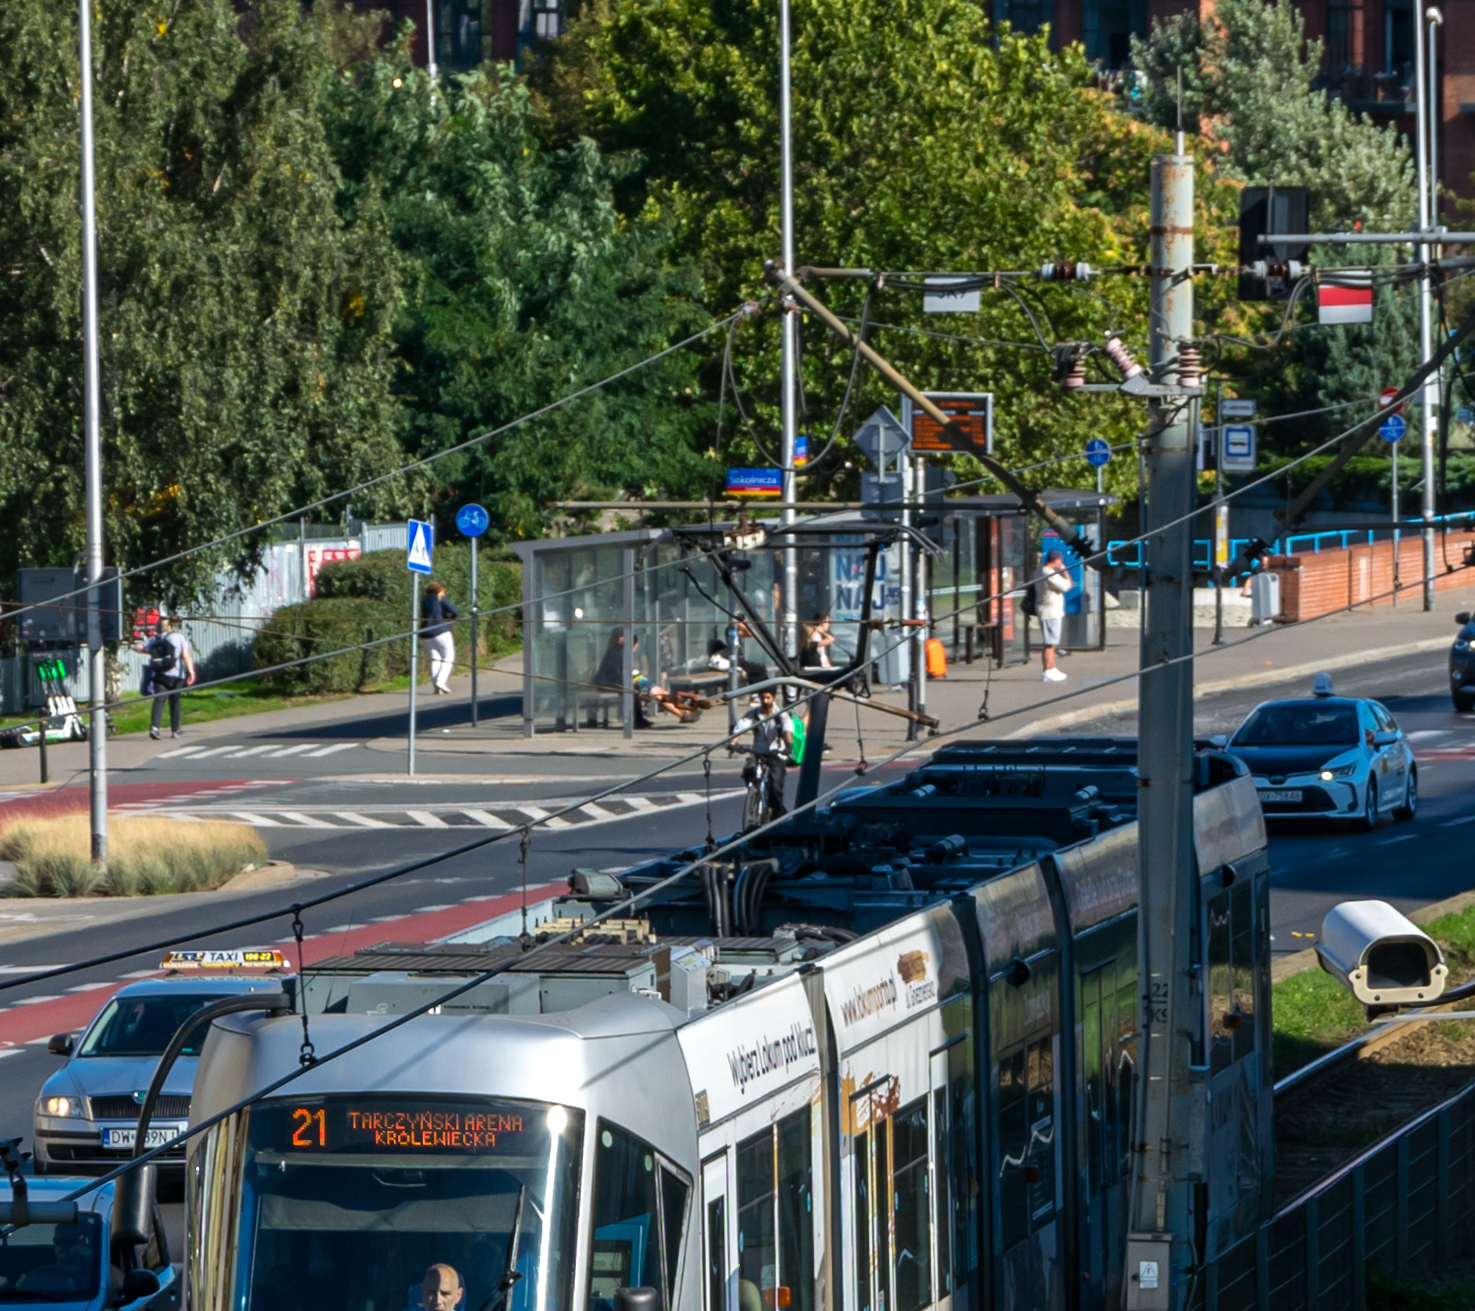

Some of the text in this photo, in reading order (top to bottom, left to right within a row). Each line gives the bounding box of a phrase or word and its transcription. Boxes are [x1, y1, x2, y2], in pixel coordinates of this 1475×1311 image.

[210, 952, 238, 961] TAXI
[292, 1108, 523, 1147] 21 TARCZYŃSKI ARENA
[111, 1130, 130, 1144] DW
